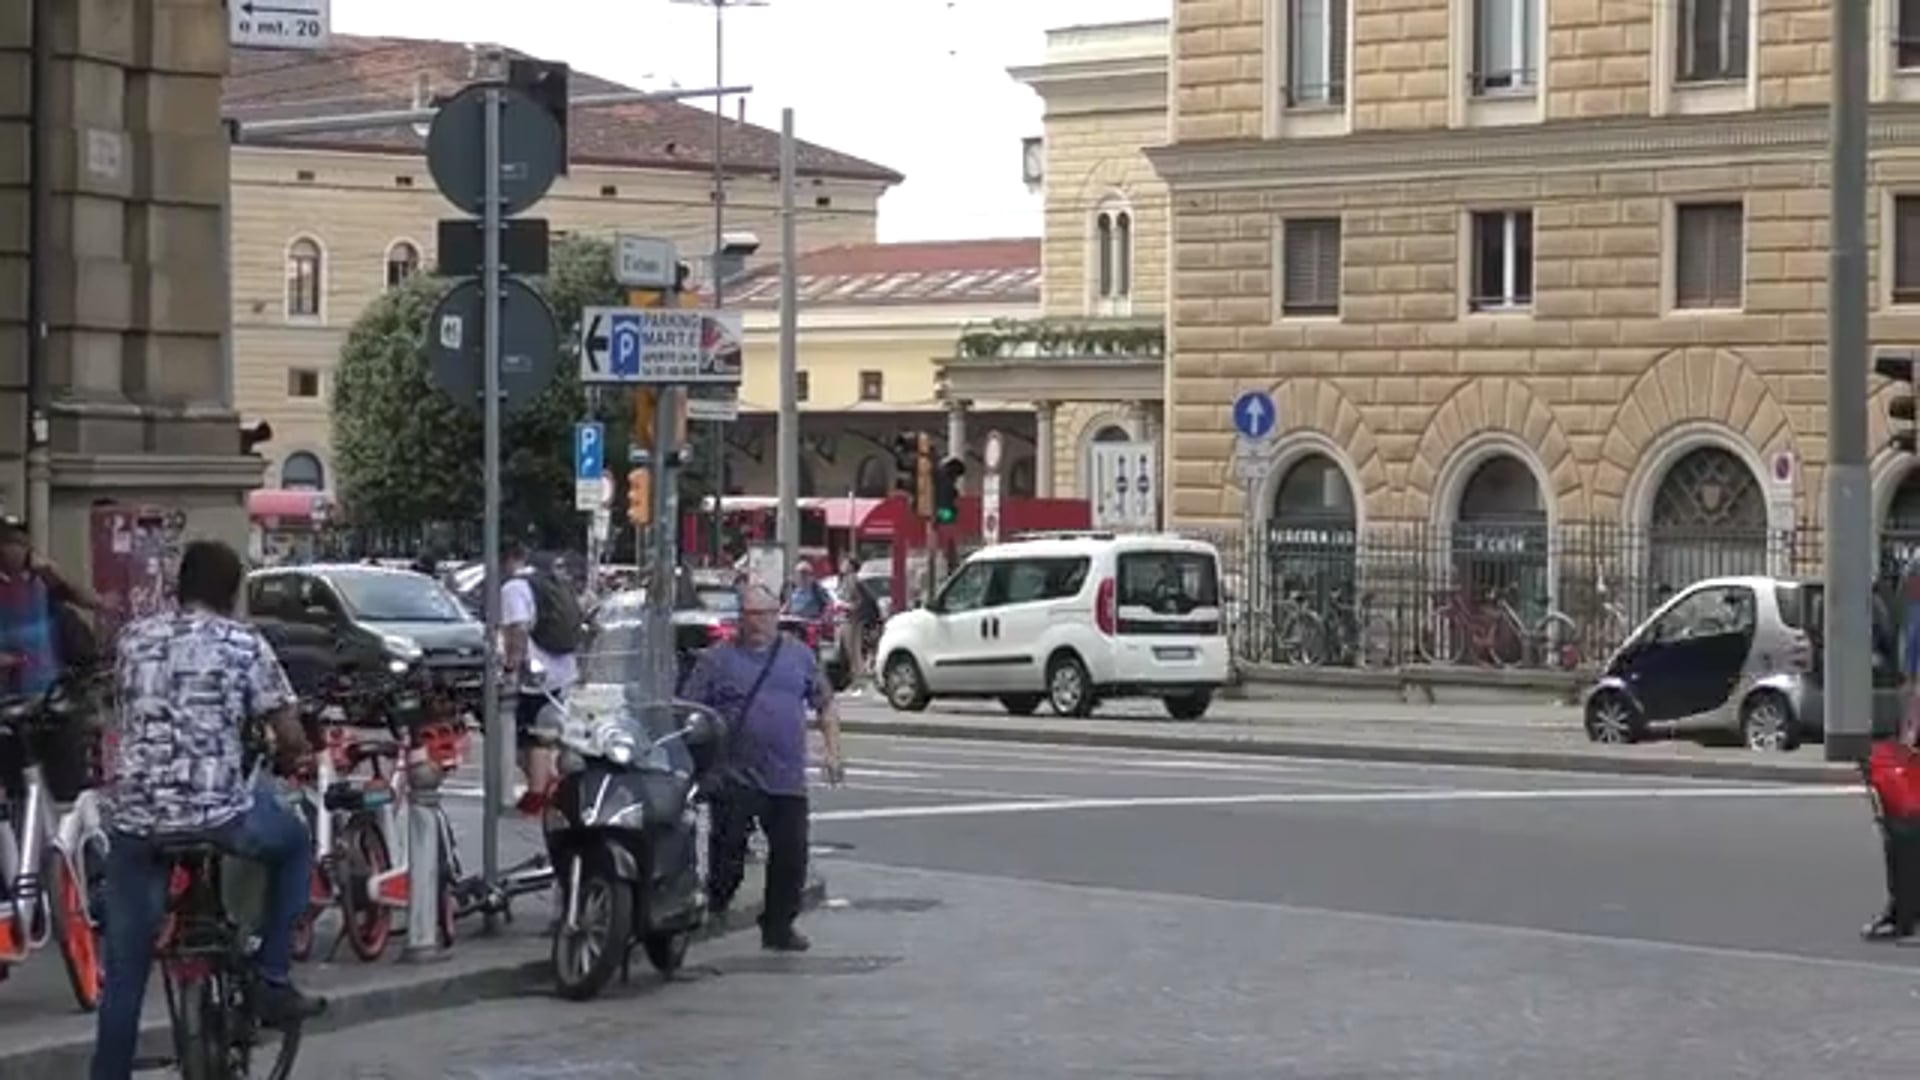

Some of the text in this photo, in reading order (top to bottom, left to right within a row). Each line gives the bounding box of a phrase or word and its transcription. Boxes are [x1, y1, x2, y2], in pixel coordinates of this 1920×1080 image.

[296, 19, 322, 37] 20
[643, 312, 698, 328] PARKING
[642, 331, 696, 348] MARTE
[581, 426, 597, 454] P
